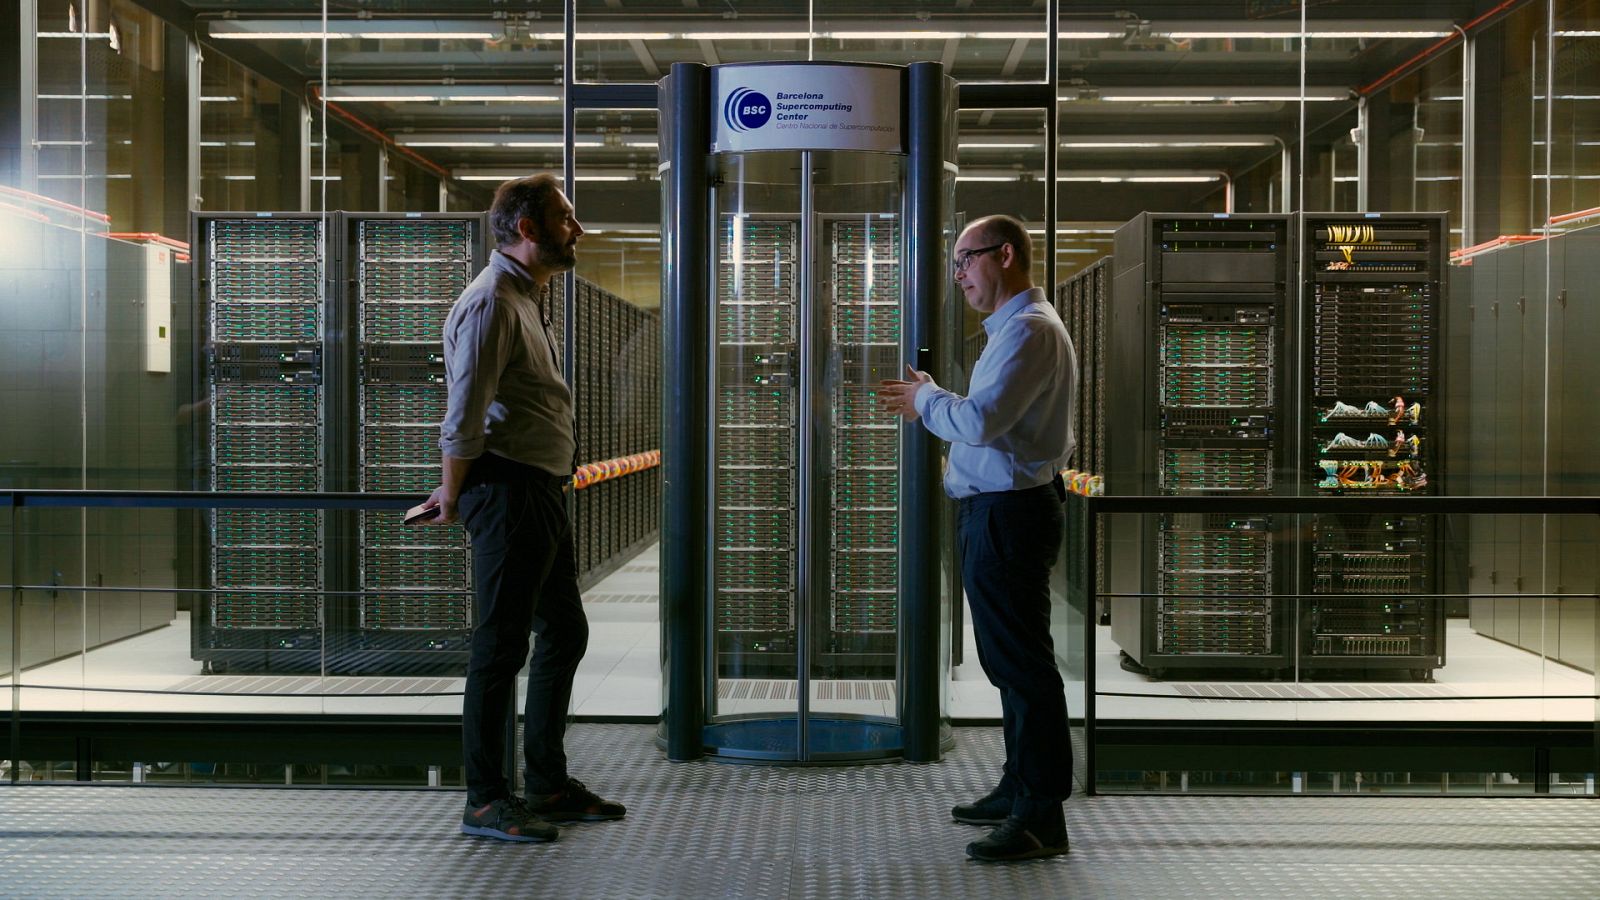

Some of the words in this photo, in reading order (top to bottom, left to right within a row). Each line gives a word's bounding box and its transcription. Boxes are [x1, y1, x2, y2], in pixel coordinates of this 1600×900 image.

[776, 92, 824, 100] Barcelona
[742, 105, 766, 115] BSC
[776, 103, 852, 112] Supercomputing
[776, 122, 798, 130] Centro
